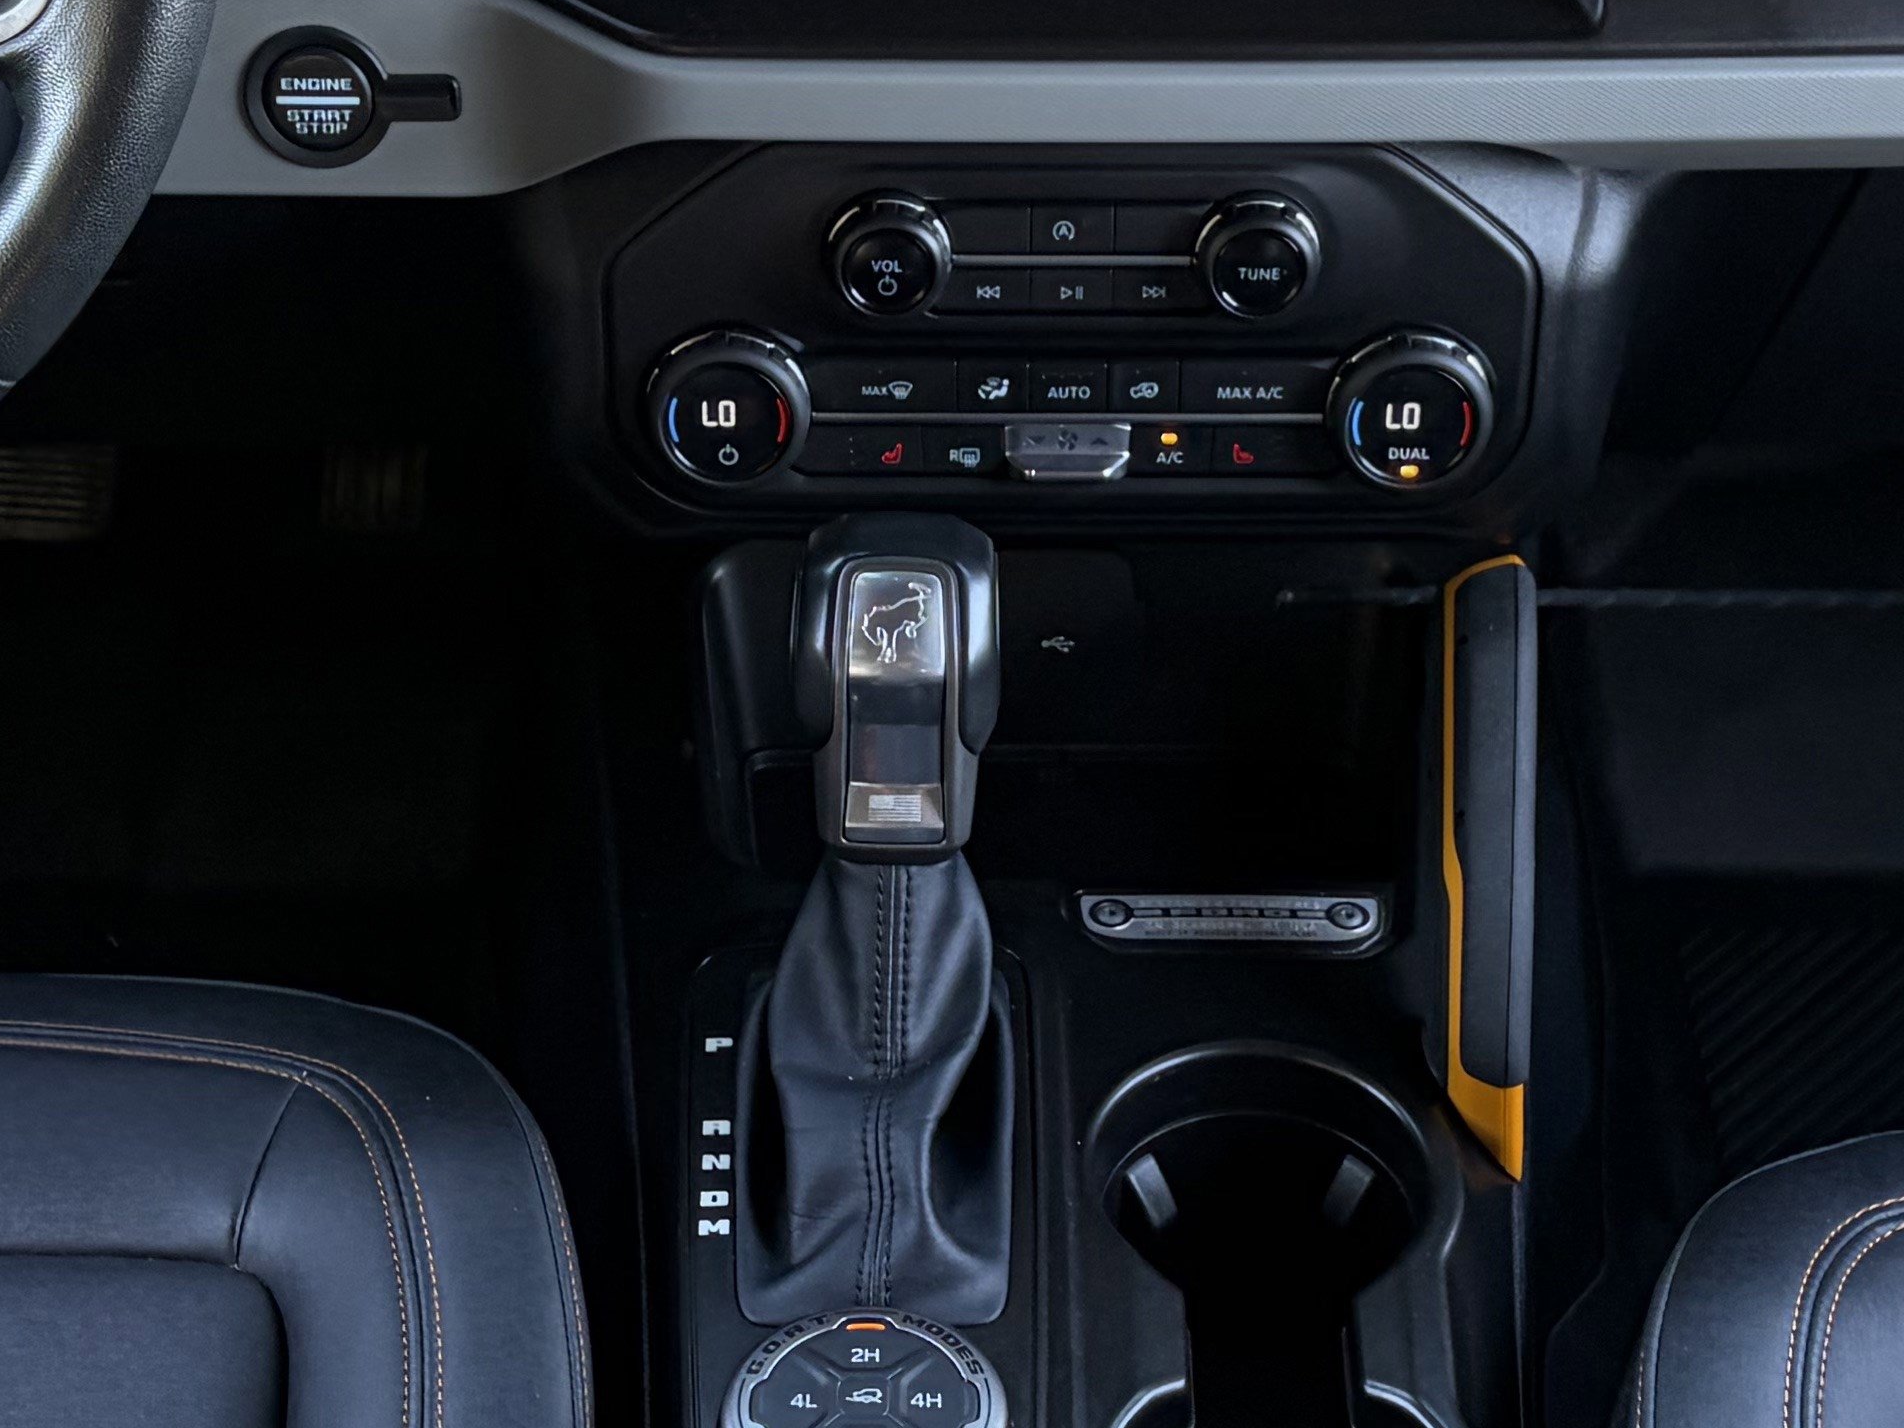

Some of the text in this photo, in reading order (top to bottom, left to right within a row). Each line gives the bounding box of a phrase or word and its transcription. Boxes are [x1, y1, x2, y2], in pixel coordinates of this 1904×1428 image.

[280, 77, 353, 91] ENGINE
[286, 109, 353, 122] START
[295, 121, 348, 134] STOP
[871, 259, 902, 273] VOL
[1238, 266, 1281, 281] TUNE
[861, 385, 888, 396] MAX
[1047, 386, 1091, 400] AUTO
[1217, 386, 1284, 400] MAX A/C
[701, 400, 737, 428] LO
[1385, 402, 1421, 431] LO
[1156, 452, 1184, 465] A/C
[1388, 447, 1430, 460] DUAL
[704, 1037, 733, 1052] P
[702, 1154, 730, 1170] N
[700, 1190, 729, 1207] D
[698, 1219, 730, 1236] M
[901, 1314, 985, 1375] MODES
[851, 1348, 880, 1363] 2H
[790, 1393, 817, 1408] 4L
[910, 1393, 942, 1408] 4H
